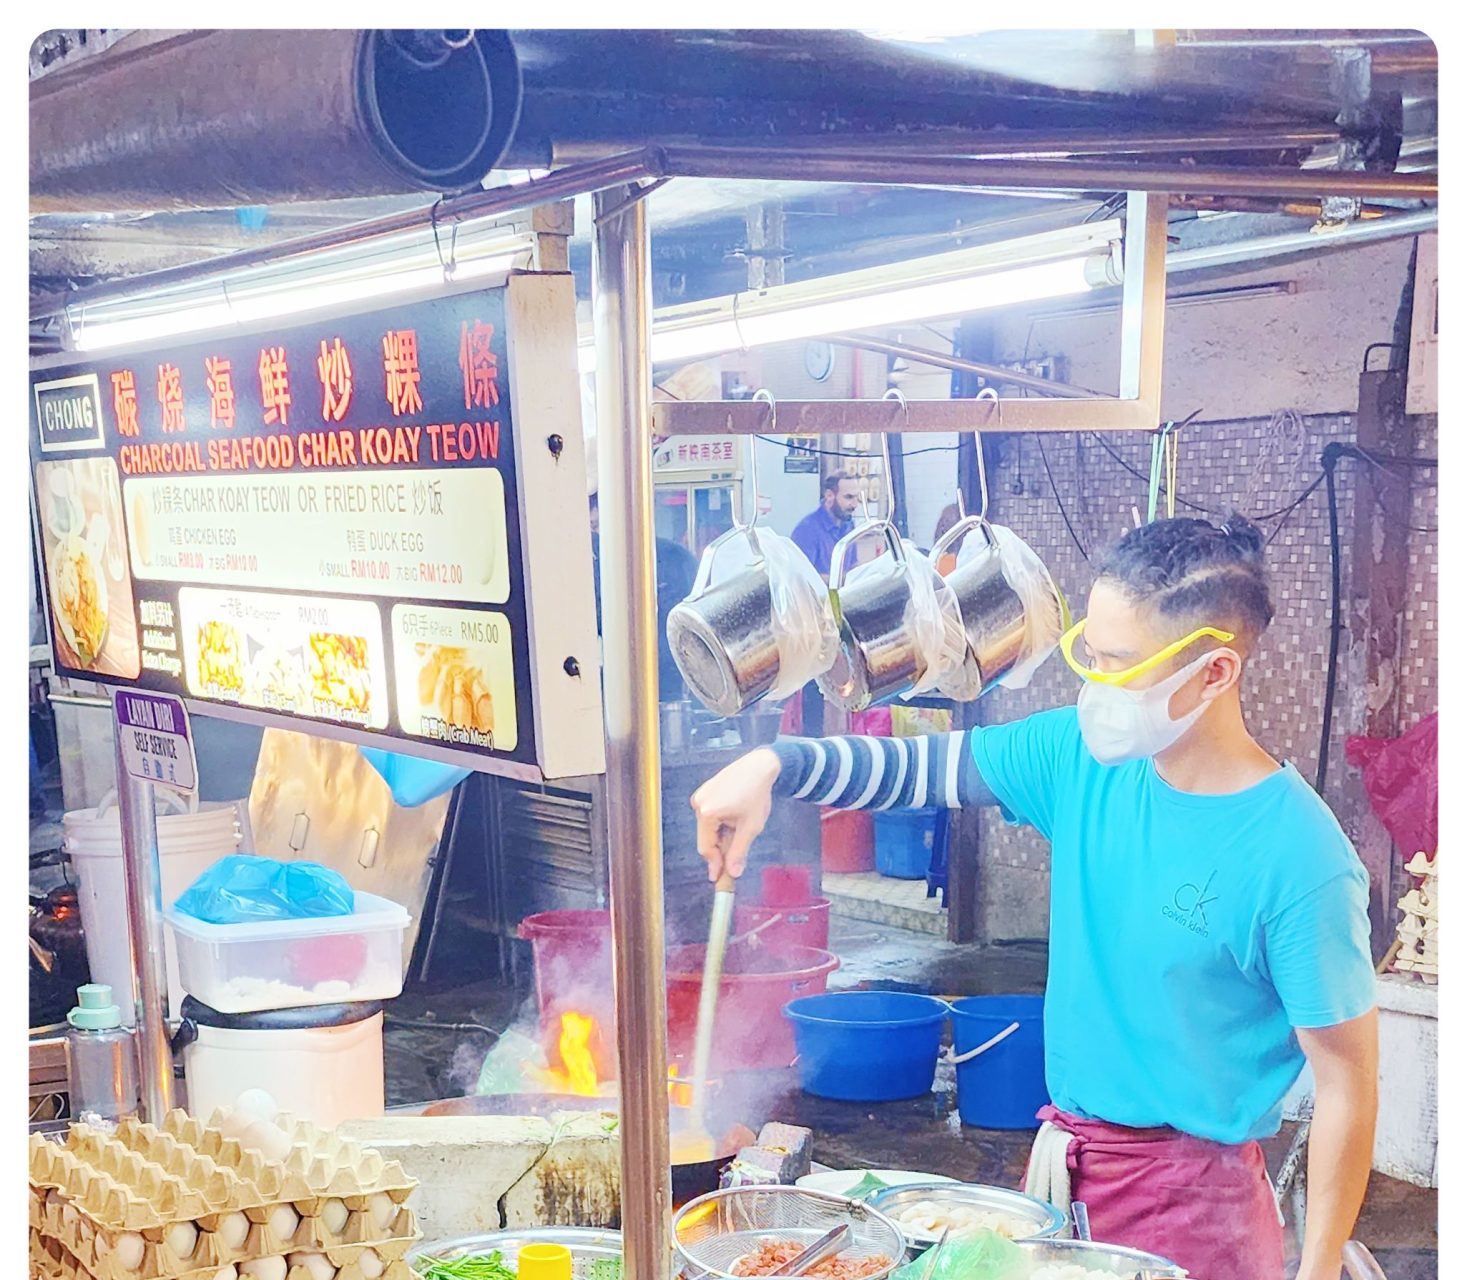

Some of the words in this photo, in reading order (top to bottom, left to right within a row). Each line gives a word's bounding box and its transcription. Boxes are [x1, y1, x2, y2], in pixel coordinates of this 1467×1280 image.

[44, 396, 94, 432] CHONG
[120, 441, 206, 474] CHARCOAL
[207, 435, 295, 470] SEAFOOD
[298, 430, 357, 467] CHAR
[359, 426, 421, 465] KOAY
[426, 421, 500, 461] TEOW
[183, 487, 216, 513] CHAR
[218, 487, 251, 513] KOAY
[252, 486, 291, 513] TEOW
[297, 485, 319, 513] OR
[324, 484, 367, 513] FRIED
[371, 484, 407, 513] RICE
[412, 480, 444, 516] 炒饭
[184, 527, 217, 546] CHICKEN
[219, 529, 237, 546] EGG
[369, 531, 400, 552] DUCK
[401, 533, 425, 553] EGG
[351, 559, 391, 581] RM10.00
[419, 562, 463, 585] RM12.00
[460, 620, 499, 644] RM5.00
[125, 696, 156, 729] LAYAN
[153, 701, 176, 732] DIRI
[133, 730, 149, 753] SELF
[149, 732, 178, 760] SERVICE
